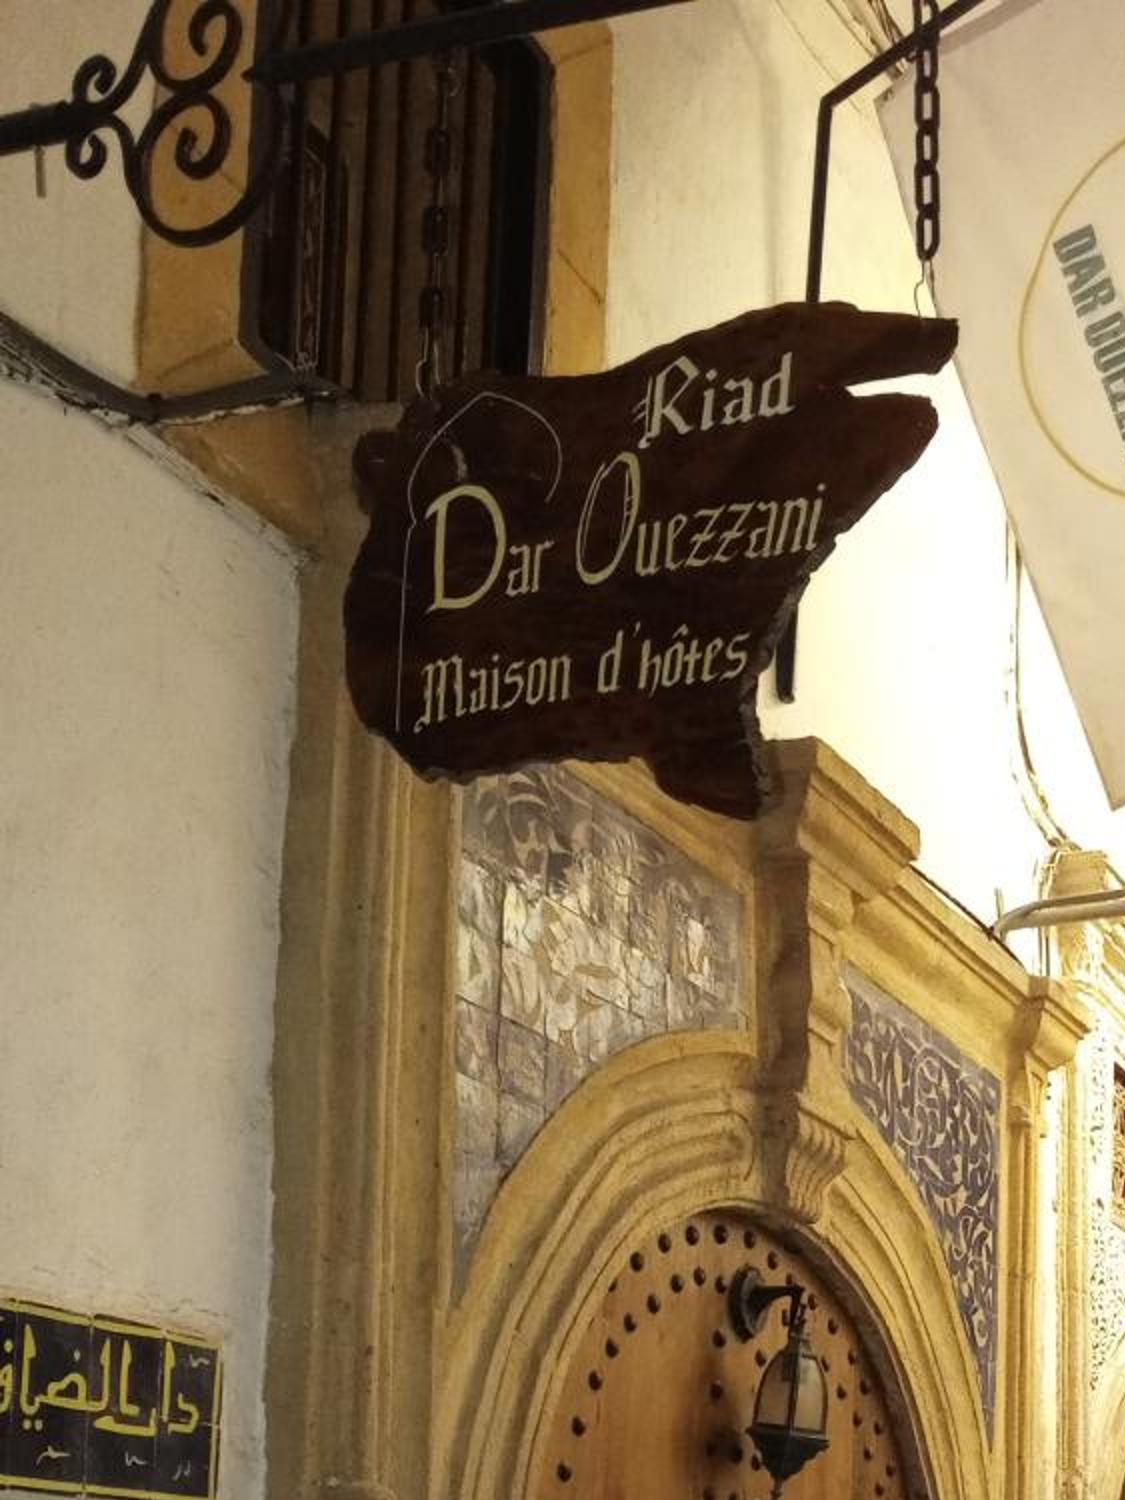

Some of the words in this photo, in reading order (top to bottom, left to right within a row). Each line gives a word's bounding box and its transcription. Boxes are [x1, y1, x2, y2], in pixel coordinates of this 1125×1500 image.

[1053, 223, 1116, 318] DAR
[632, 351, 797, 449] Riad
[424, 485, 556, 615] Dar
[575, 451, 827, 586] Ouezzani
[413, 653, 572, 733] Maison
[596, 620, 751, 698] d'hôtes
